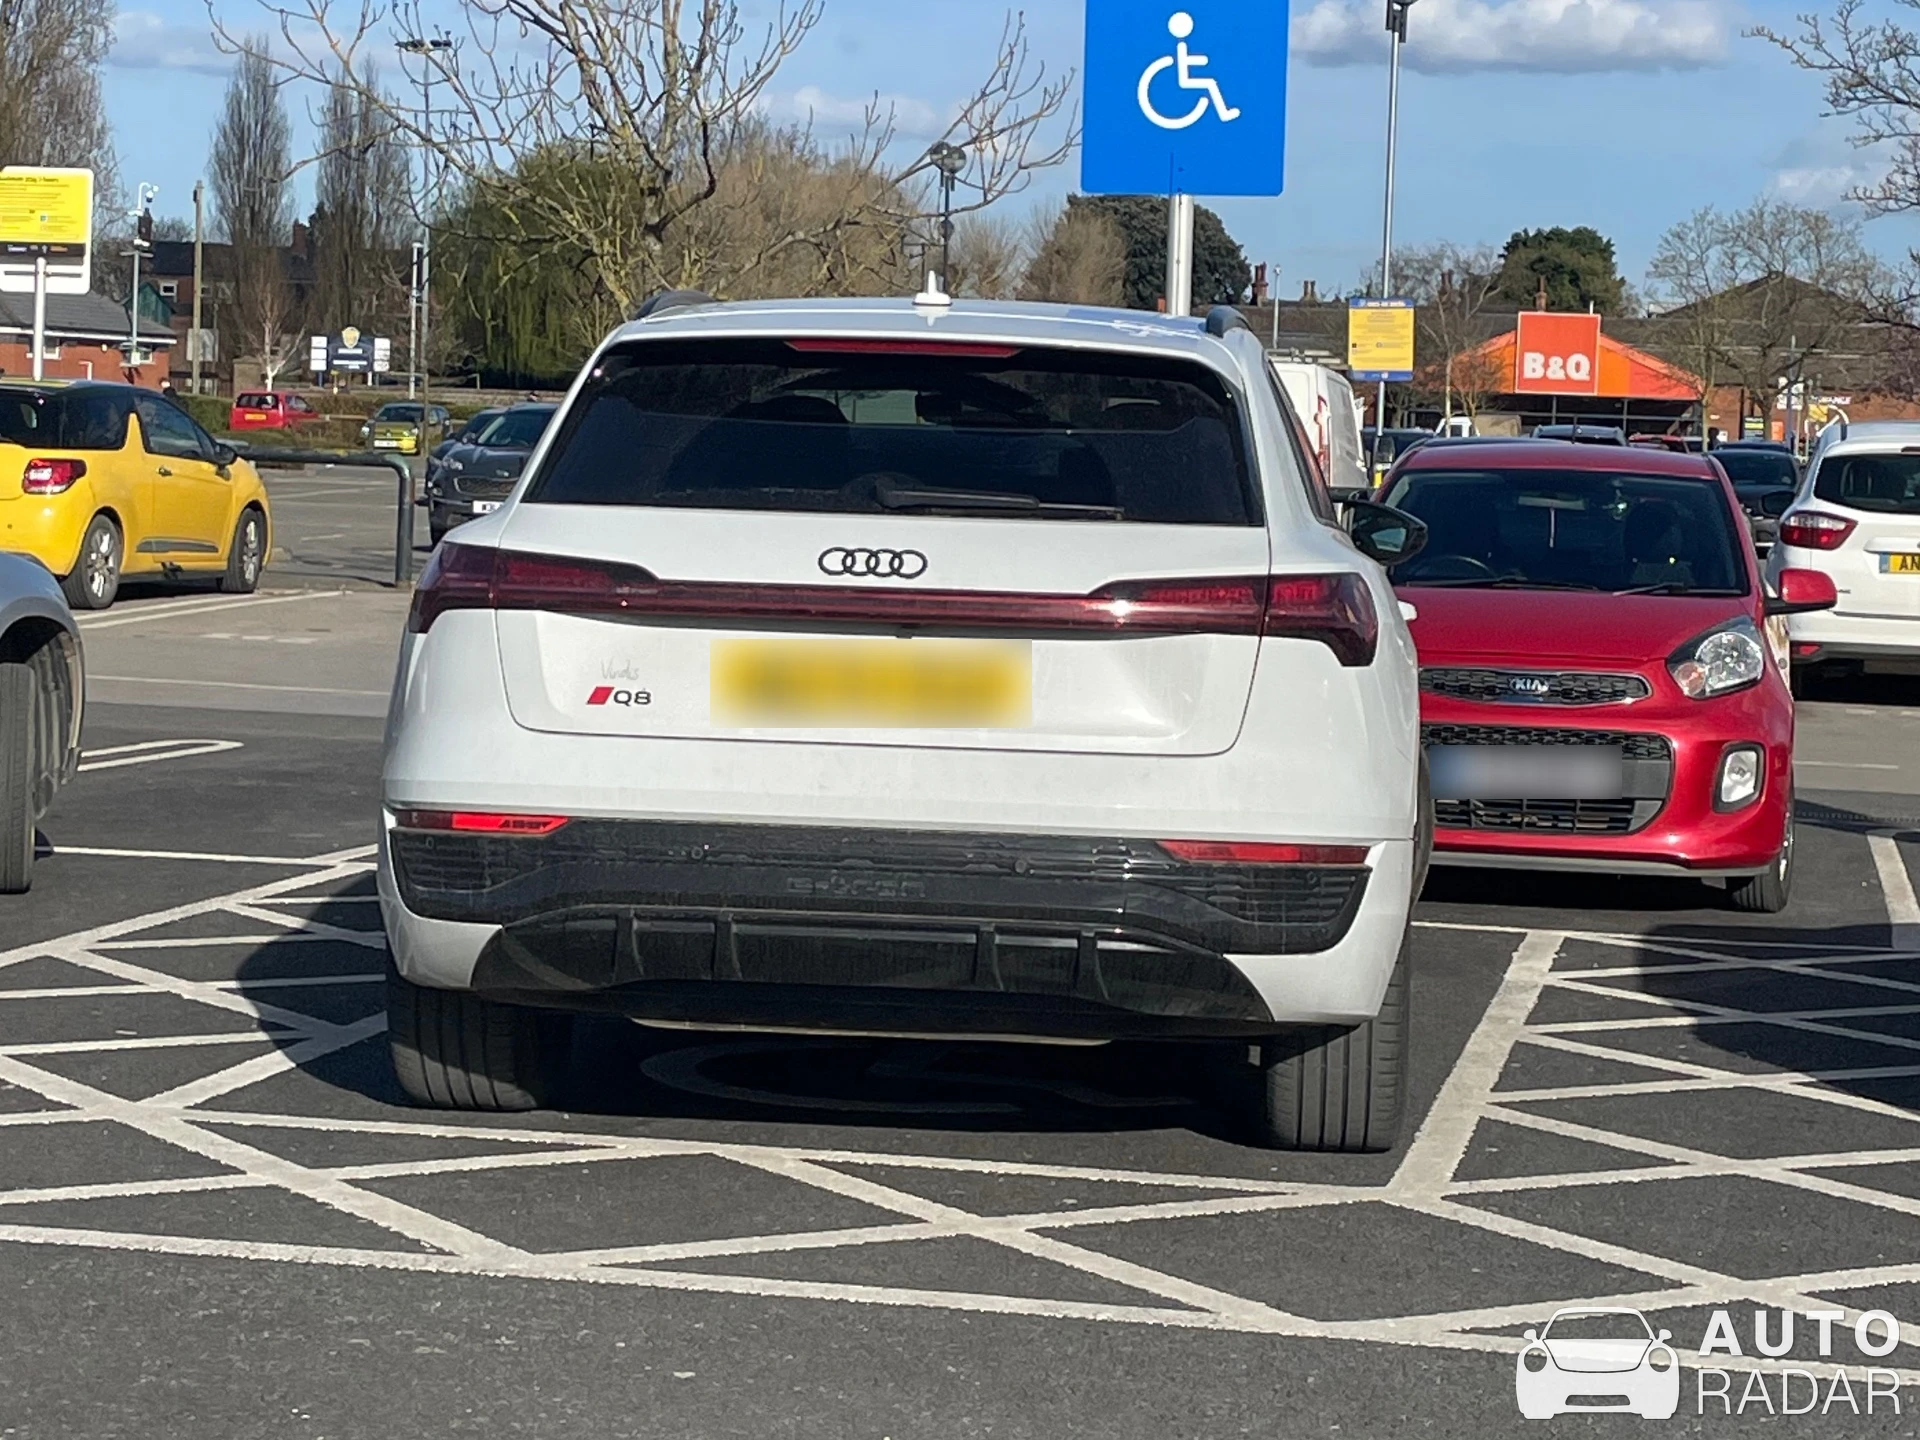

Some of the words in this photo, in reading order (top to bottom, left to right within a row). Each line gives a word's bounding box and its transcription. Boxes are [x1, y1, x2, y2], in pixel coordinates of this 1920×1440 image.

[1523, 352, 1590, 381] B&Q
[1515, 678, 1549, 692] KIA
[613, 690, 652, 707] Q8
